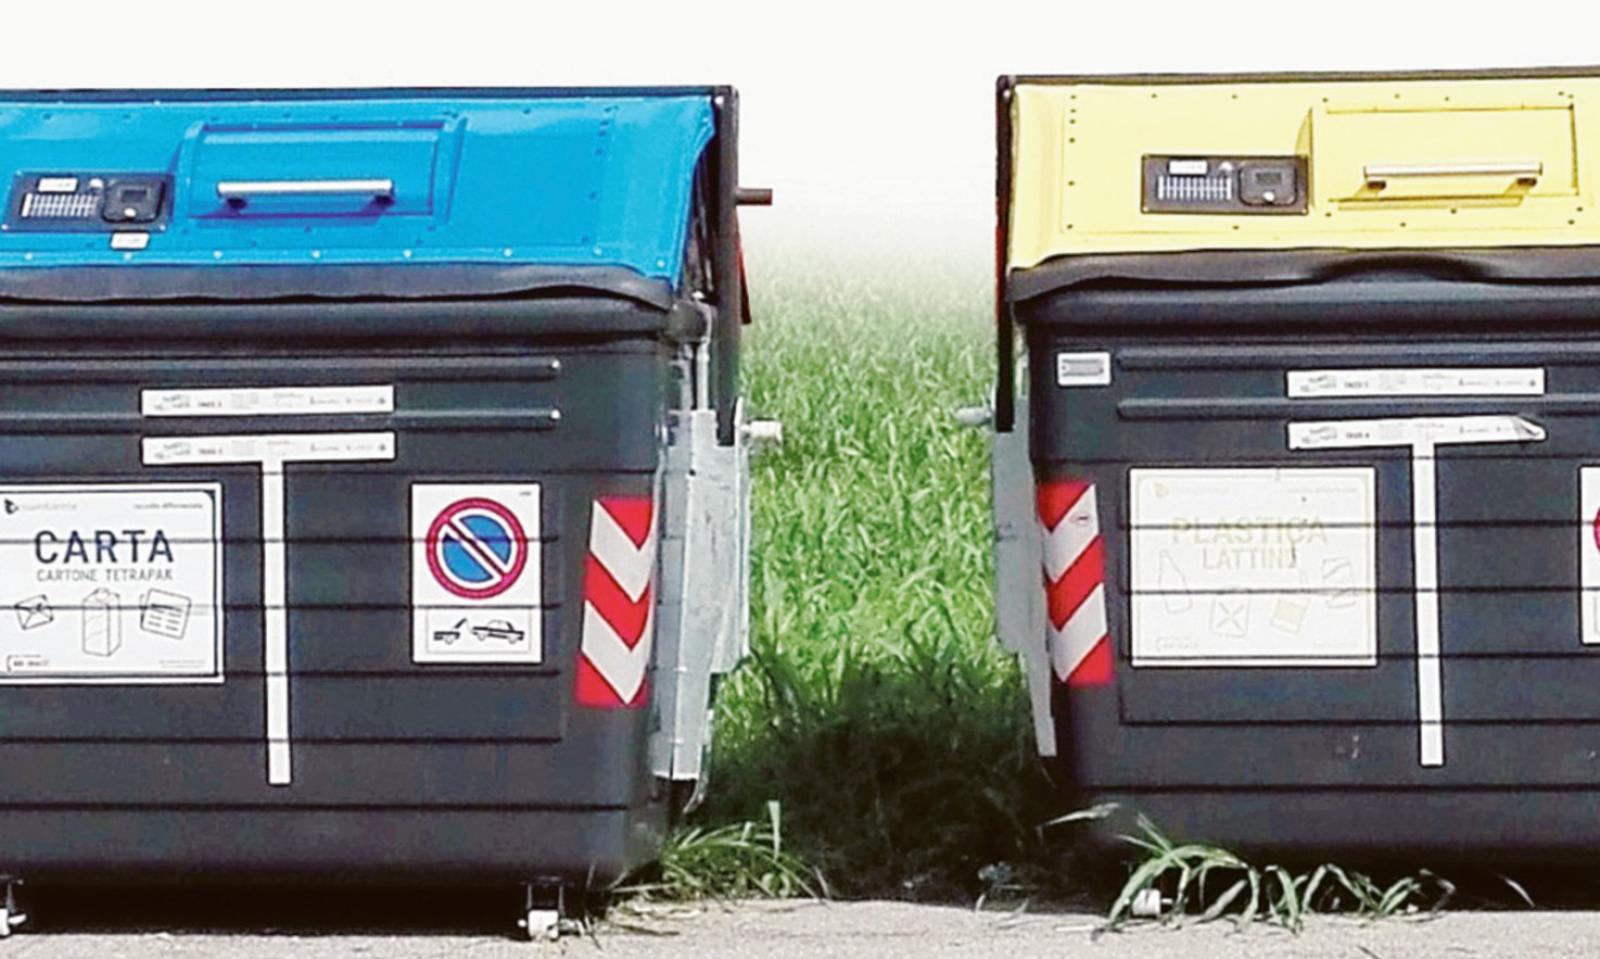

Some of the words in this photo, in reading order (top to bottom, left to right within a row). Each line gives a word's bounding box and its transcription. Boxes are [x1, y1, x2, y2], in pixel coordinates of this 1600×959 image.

[1171, 516, 1328, 544] PLASTICA
[34, 530, 174, 564] CARTA
[37, 569, 98, 582] CARTONE
[106, 568, 173, 581] TETRAPAK
